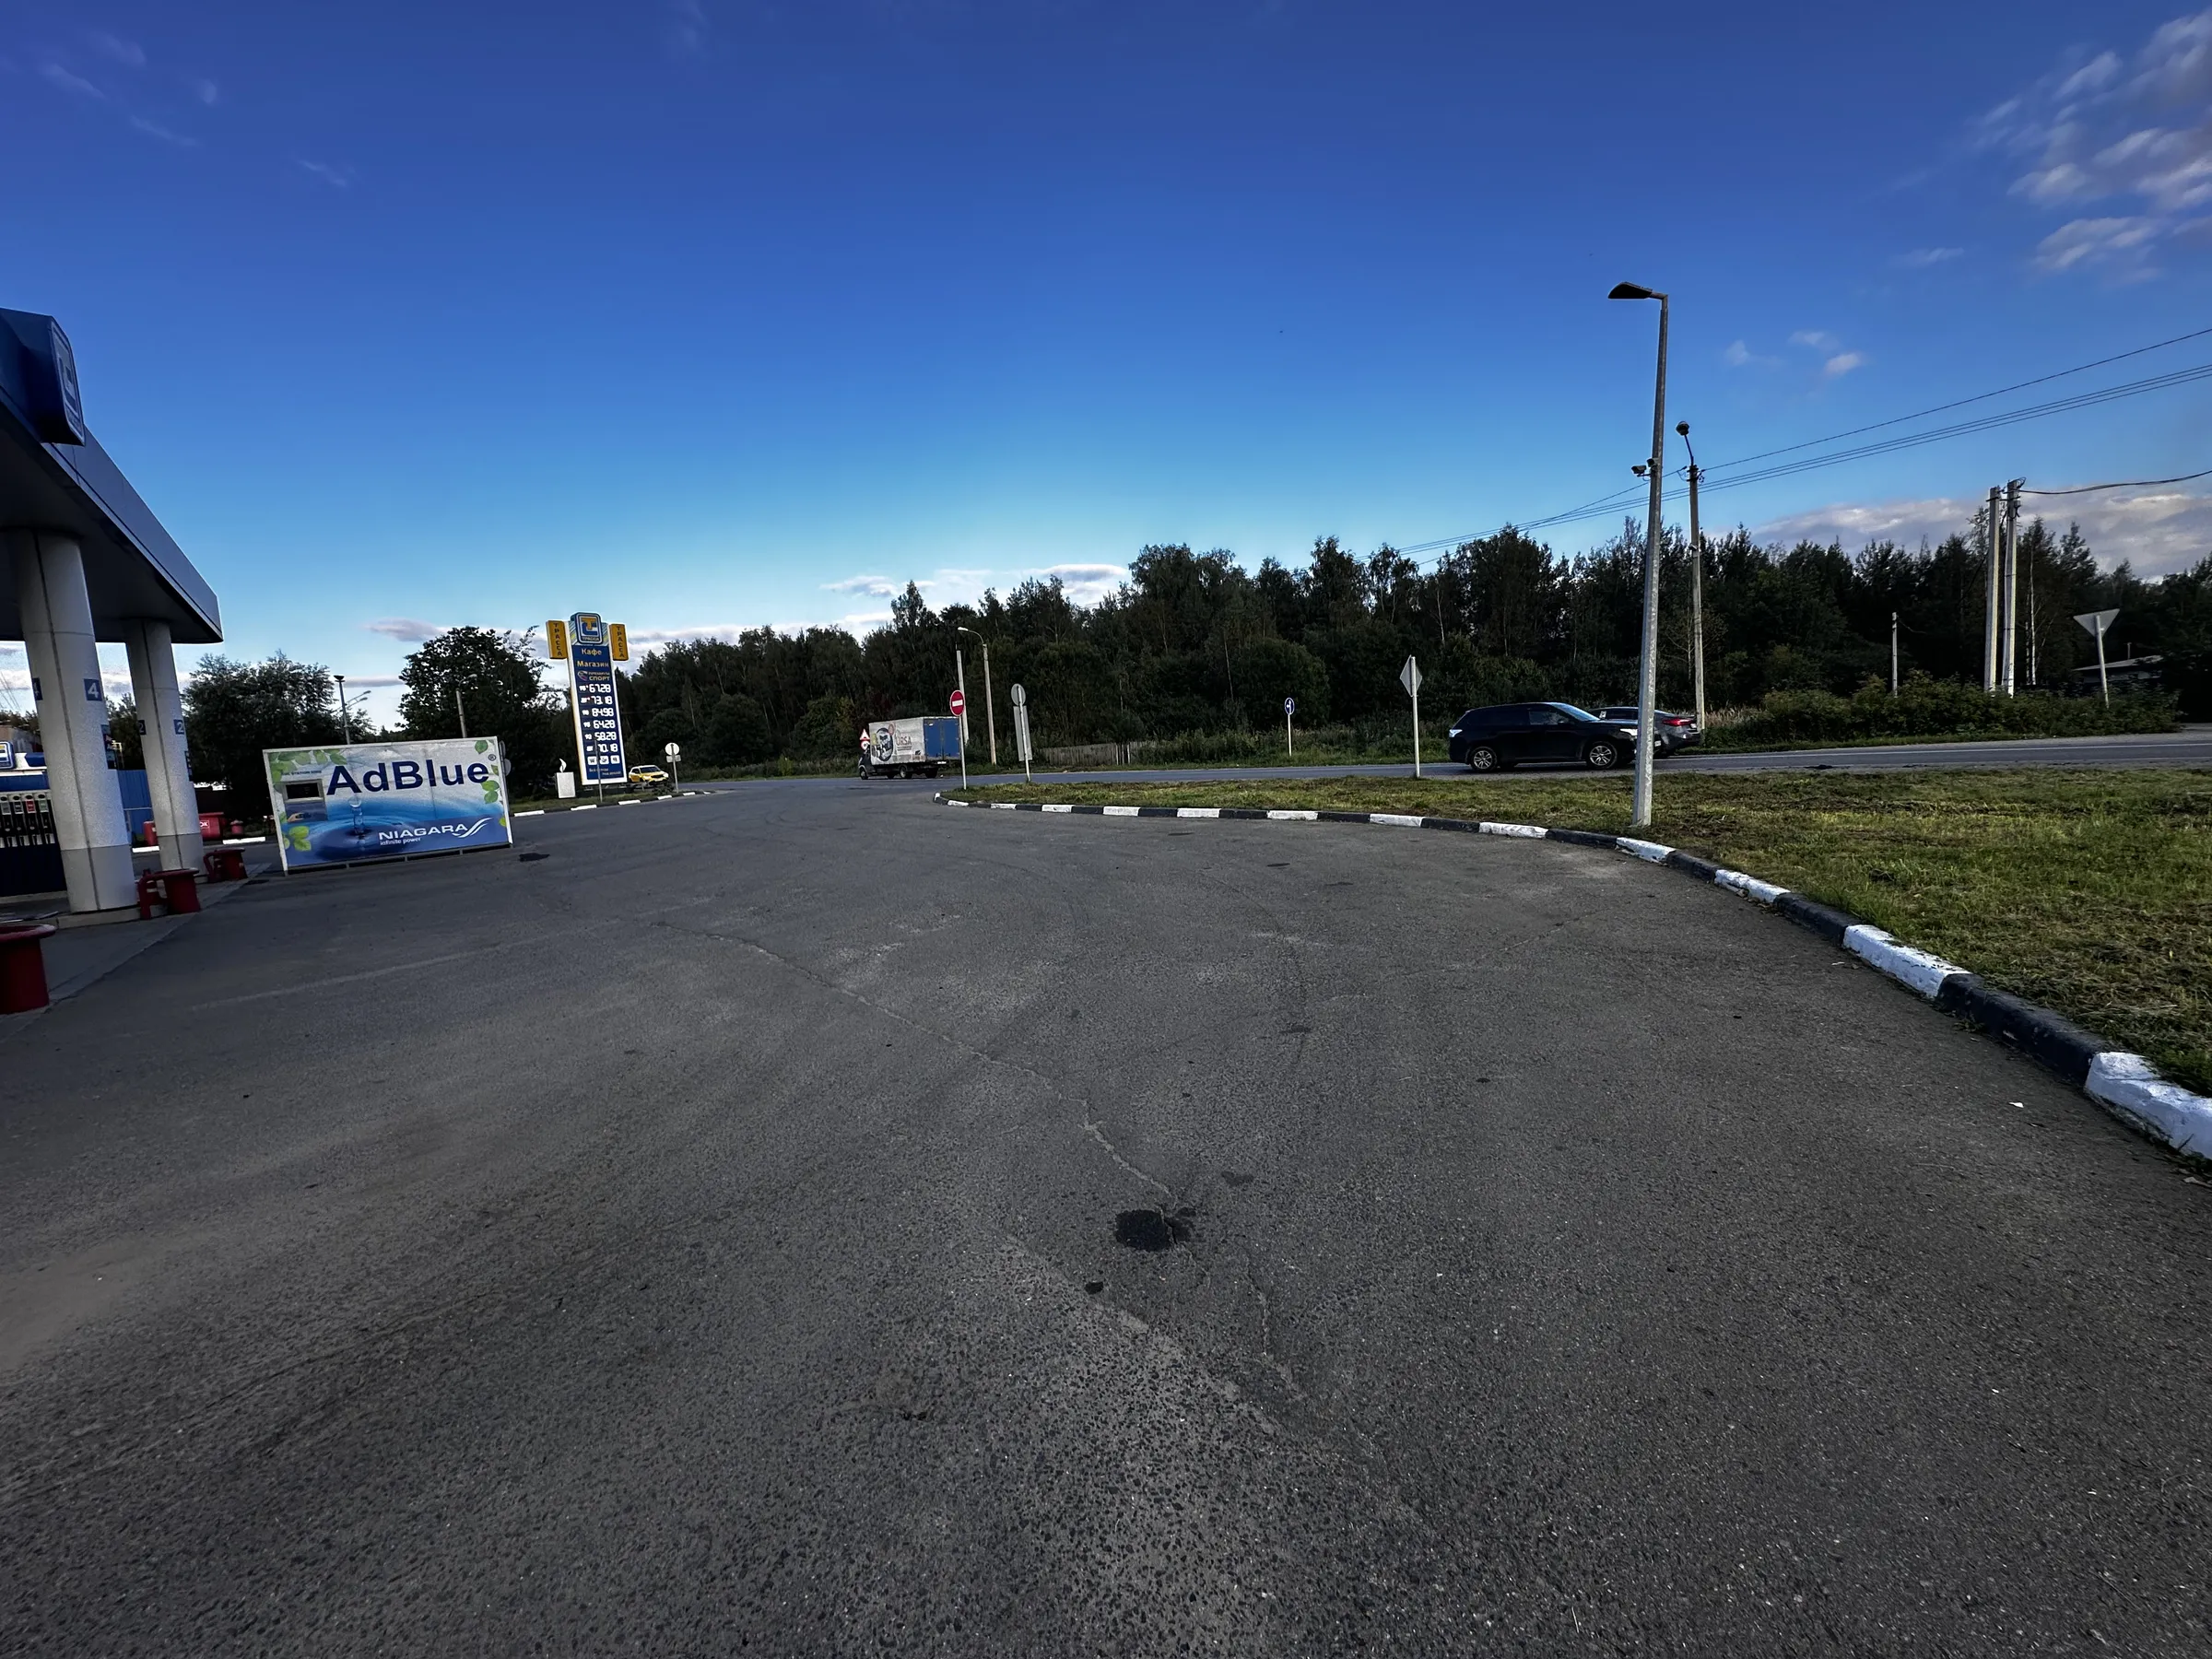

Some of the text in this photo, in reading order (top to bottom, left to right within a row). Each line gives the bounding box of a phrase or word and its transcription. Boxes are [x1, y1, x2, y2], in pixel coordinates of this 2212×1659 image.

[553, 623, 563, 657] ТРАССА
[617, 626, 625, 657] ТРАССА
[581, 648, 602, 656] Кафе
[577, 660, 610, 668] Магазин
[88, 682, 100, 699] 4
[177, 724, 184, 733] 2
[326, 759, 489, 795] AdBlue
[379, 823, 468, 841] NIAGARA
[403, 837, 421, 845] power
